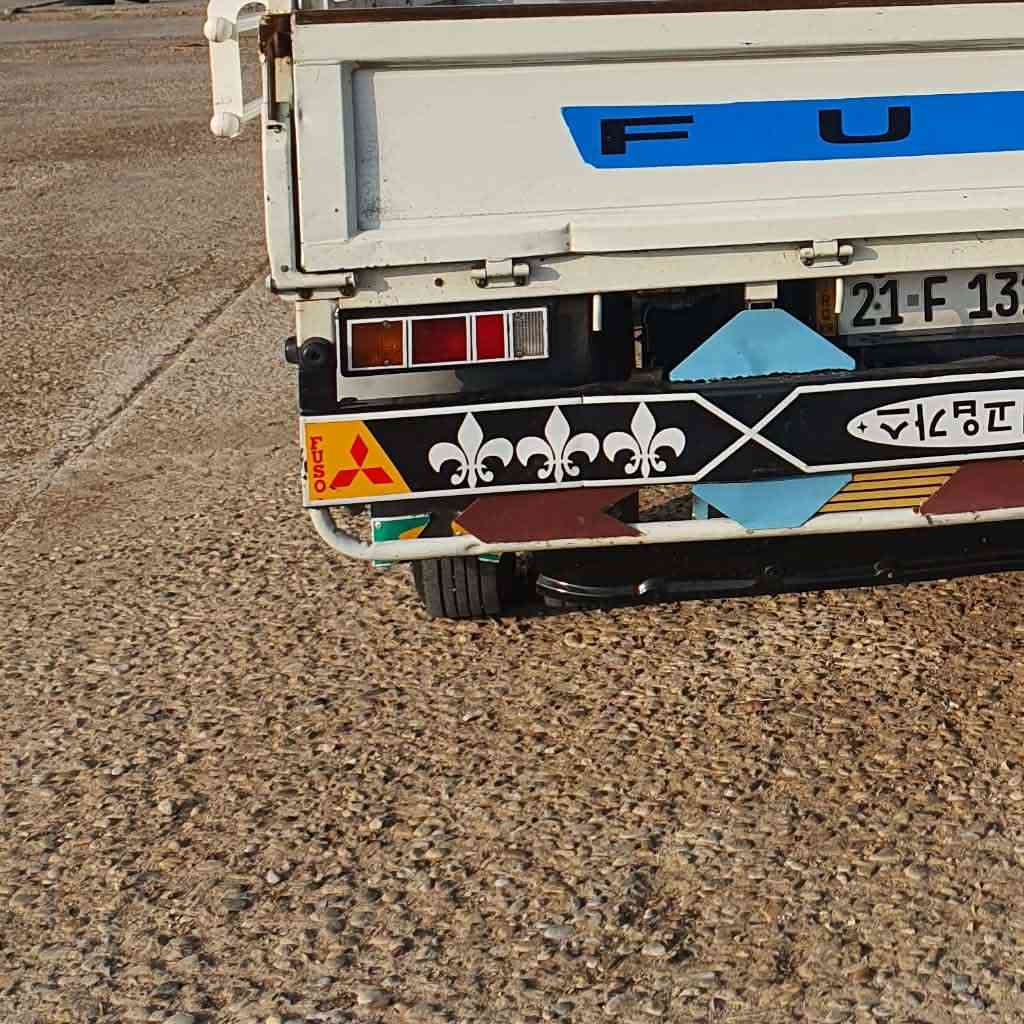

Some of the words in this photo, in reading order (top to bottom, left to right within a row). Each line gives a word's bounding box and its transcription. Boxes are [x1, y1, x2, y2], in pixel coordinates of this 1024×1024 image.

[851, 278, 904, 327] 21
[923, 275, 948, 322] F
[309, 436, 326, 493] FUSO
